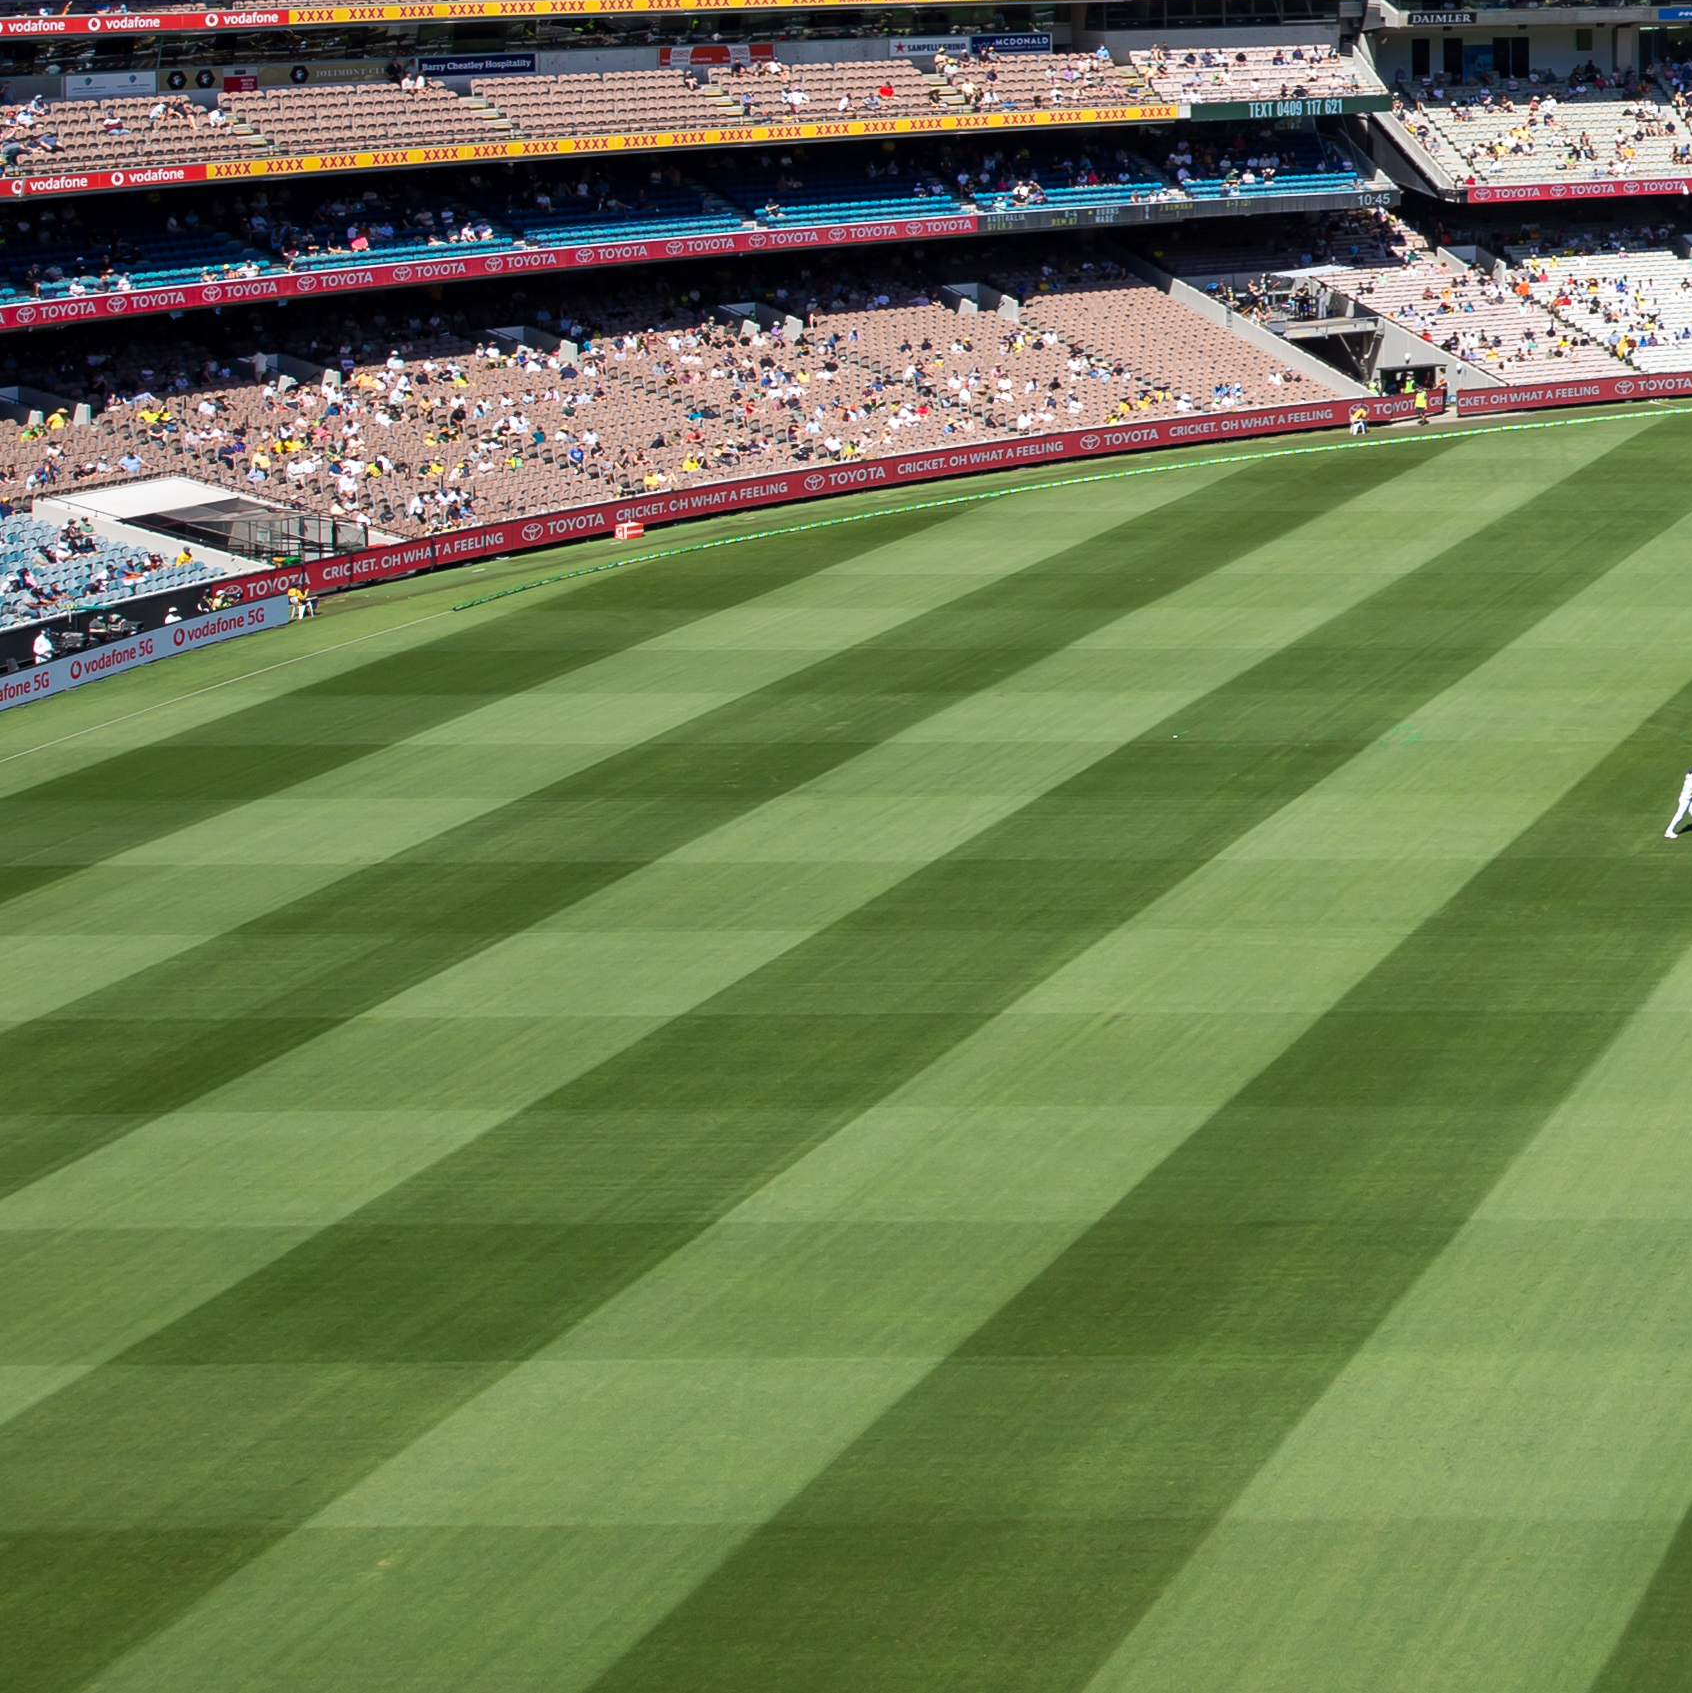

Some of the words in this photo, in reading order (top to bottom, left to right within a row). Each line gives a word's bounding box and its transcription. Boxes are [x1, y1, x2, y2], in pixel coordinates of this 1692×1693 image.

[600, 0, 633, 10] XXXX
[223, 13, 278, 24] vodafone
[299, 10, 333, 21] XXXX
[1412, 14, 1472, 24] DAIMLER
[996, 37, 1048, 46] MCDONALD
[422, 61, 444, 74] Barry
[448, 60, 483, 72] Cheatley
[485, 57, 532, 70] Hospitality
[316, 68, 365, 78] JOLIMONT
[1249, 102, 1272, 117] TEXT
[1277, 101, 1302, 116] 0409
[1306, 100, 1322, 115] 117
[1325, 99, 1343, 114] 621
[911, 119, 941, 129] XXXX
[625, 136, 657, 147] XXXX
[321, 156, 356, 168] XXXX
[30, 178, 87, 191] vodafone
[1571, 184, 1615, 197] TOYOTA
[1357, 194, 1390, 206] 10:45
[987, 214, 1025, 222] AUSTRALIA
[988, 222, 1006, 230] OVER
[1104, 429, 1158, 445] TOYOTA
[897, 458, 948, 474] CRICKET.
[950, 456, 968, 466] OH
[970, 450, 1004, 463] WHAT
[1006, 448, 1014, 458] A
[1016, 441, 1063, 456] FEELING
[547, 513, 605, 534] TOYOTA
[322, 558, 378, 580] CRICKET.
[381, 554, 401, 567] OH
[403, 544, 440, 563] WHAT
[443, 543, 452, 554] A
[454, 532, 504, 553] FEELING
[188, 616, 244, 640] vodafone
[247, 608, 264, 625] 5G
[84, 644, 136, 674] vodafone
[138, 638, 153, 656] 5G
[33, 672, 50, 690] 5G
